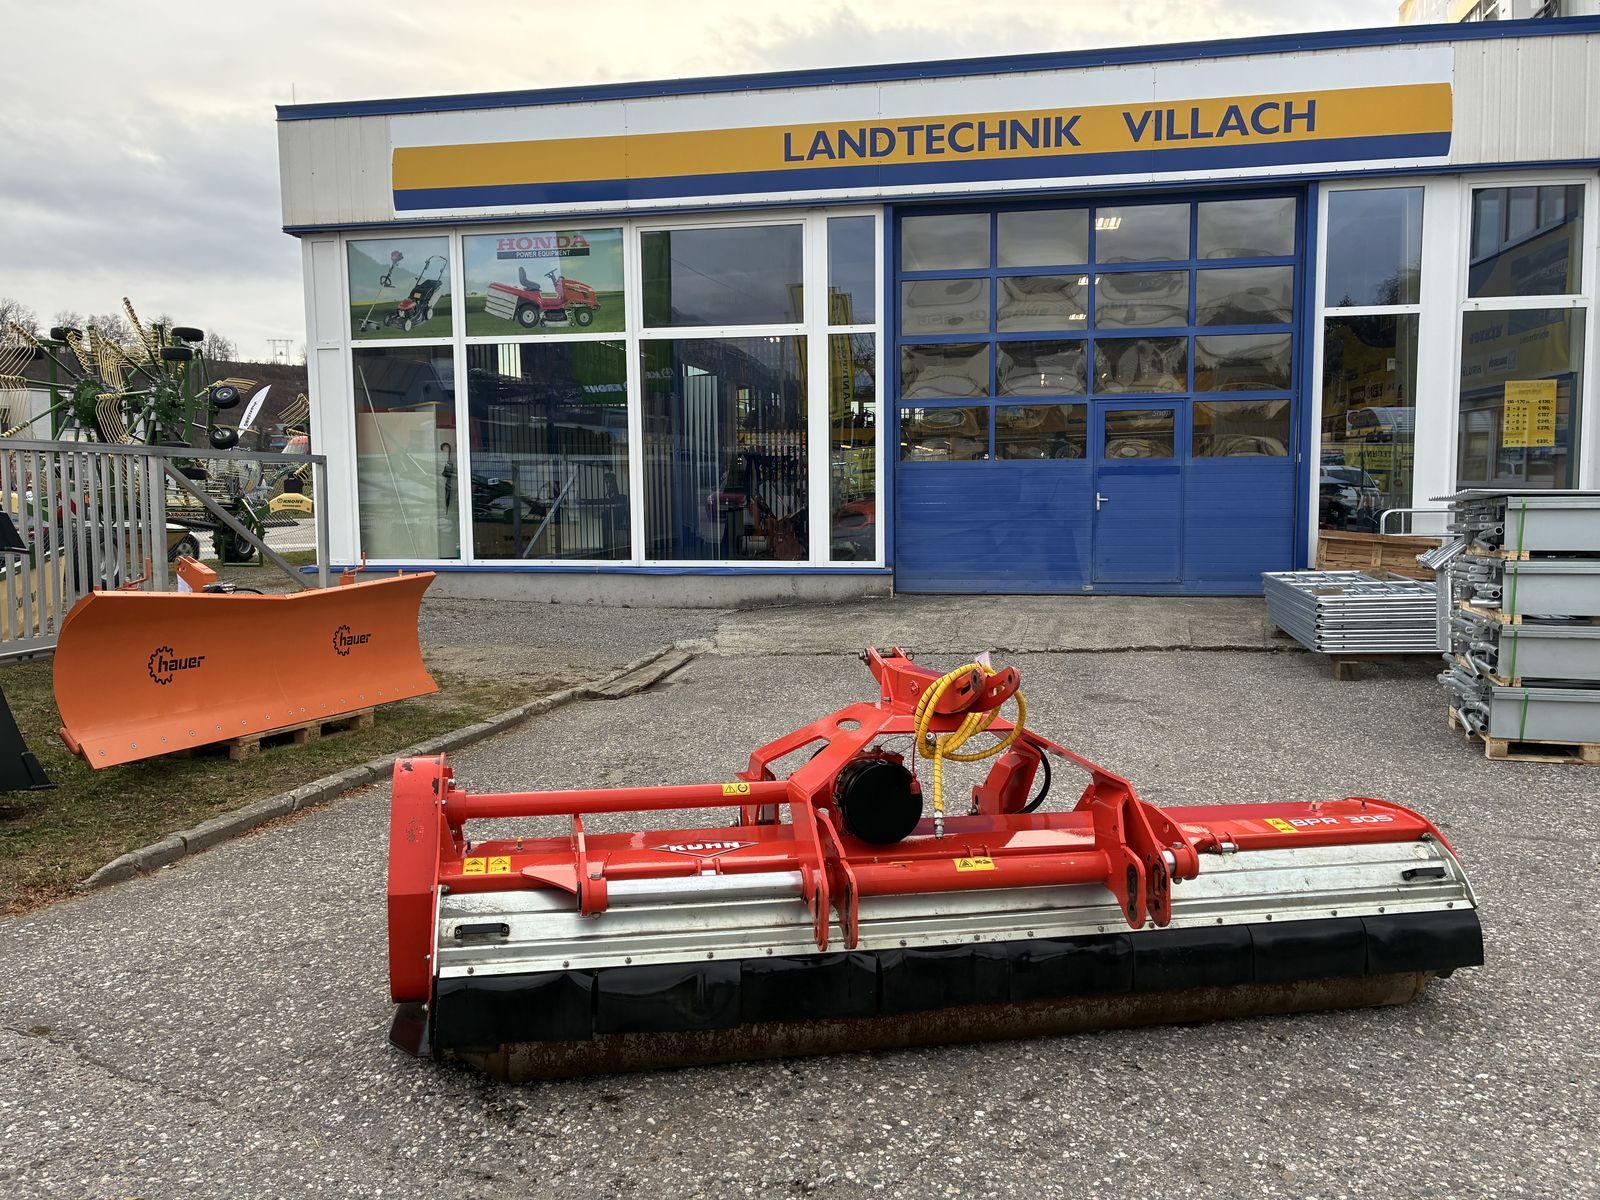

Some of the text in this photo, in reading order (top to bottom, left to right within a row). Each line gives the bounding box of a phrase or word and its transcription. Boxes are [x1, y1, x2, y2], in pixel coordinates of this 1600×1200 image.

[784, 100, 1316, 162] LANDTECHNIK VILLACH
[496, 234, 590, 251] HONDA
[339, 633, 371, 647] hauer
[157, 656, 205, 673] hauer
[1288, 814, 1394, 827] BPR 305
[669, 841, 741, 852] KUHN
